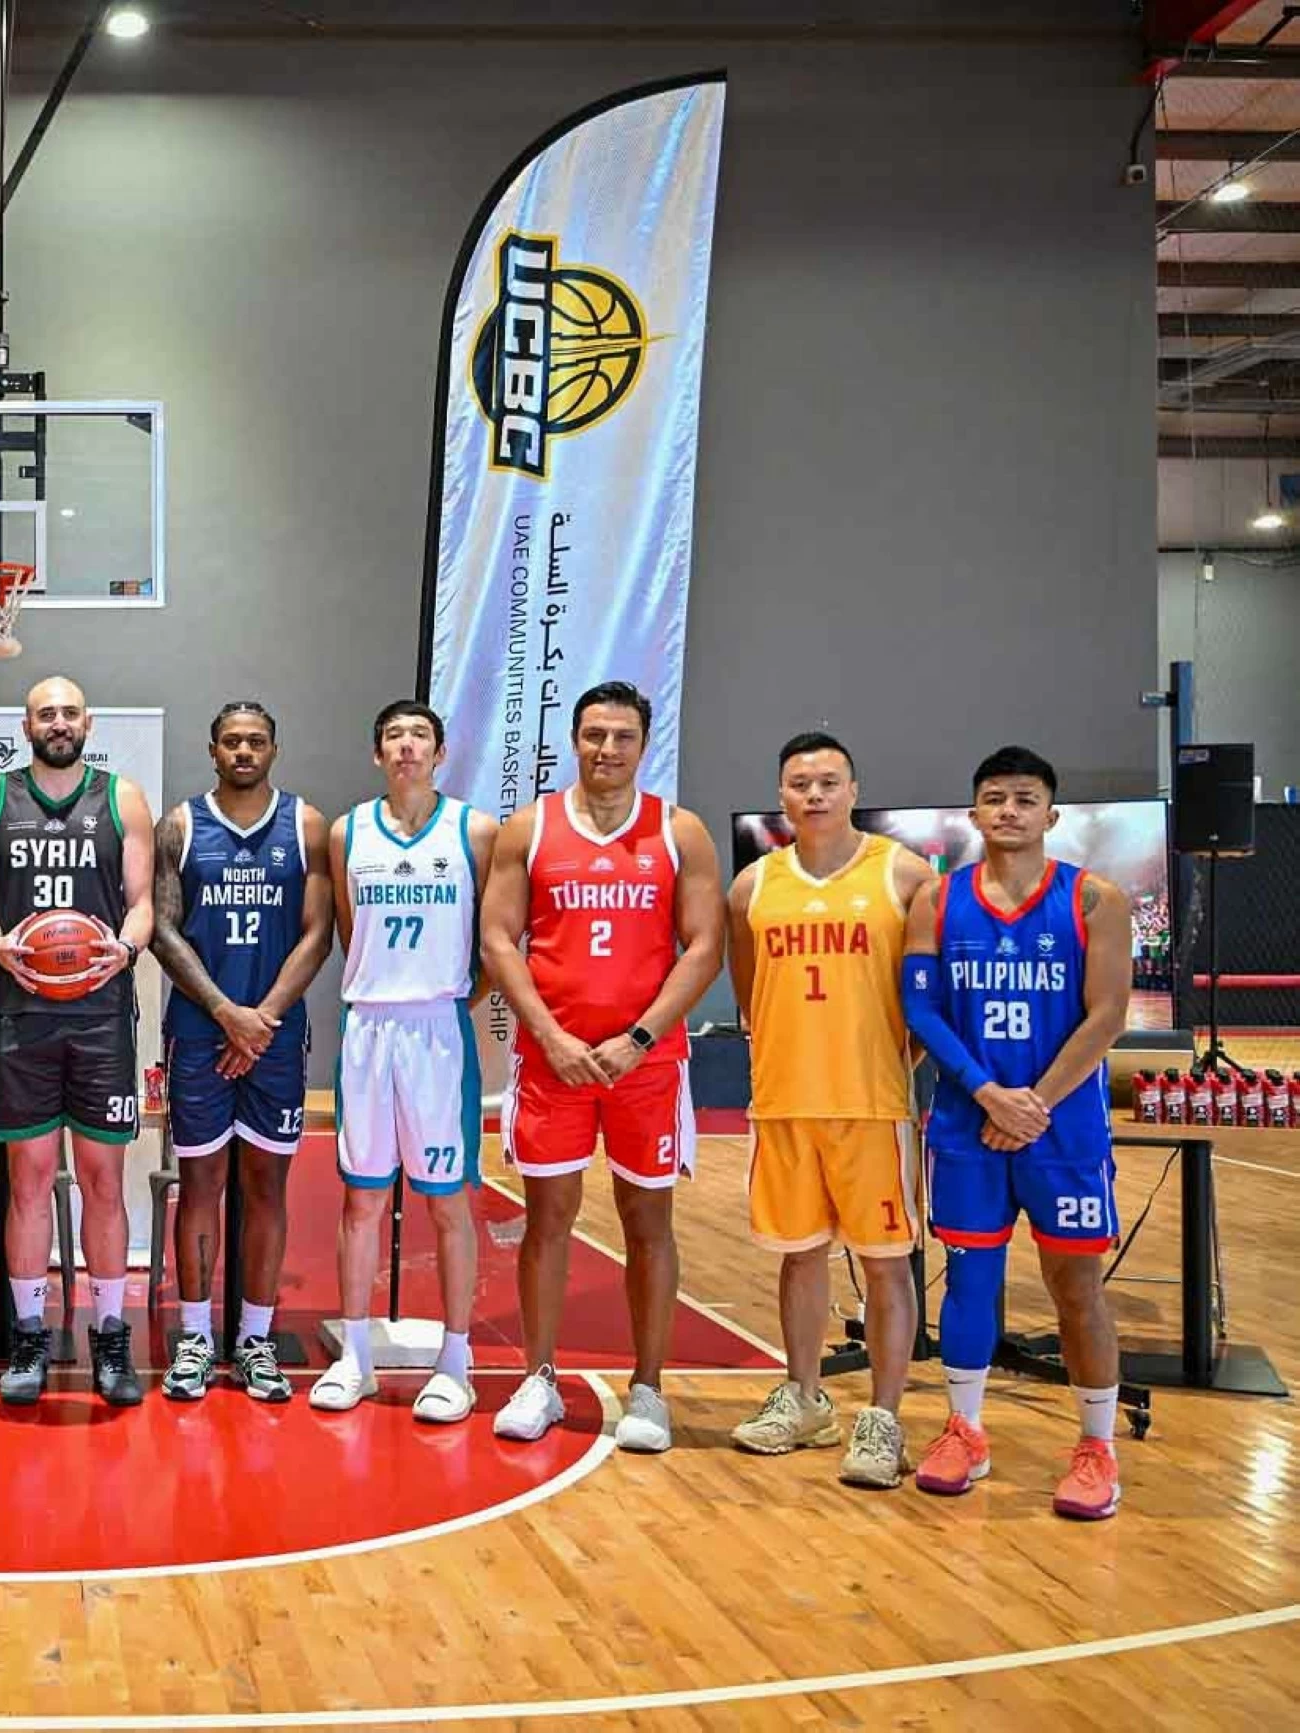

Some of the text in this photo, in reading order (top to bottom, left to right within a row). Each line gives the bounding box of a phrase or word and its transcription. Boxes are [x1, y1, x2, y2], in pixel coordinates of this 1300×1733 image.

[499, 246, 549, 467] UCBC
[512, 514, 531, 561] UAE
[504, 565, 531, 724] COMMUNITIES
[10, 838, 97, 868] SYRIA
[33, 875, 74, 908] 30
[222, 867, 267, 883] NORTH
[201, 884, 283, 906] AMERICA
[356, 883, 457, 906] UZBEKISTAN
[549, 880, 659, 911] TÜRKİYE
[225, 911, 261, 945] 12
[384, 916, 424, 950] 77
[589, 919, 613, 956] 2
[764, 922, 870, 959] CHINA
[804, 965, 828, 1001] 1
[950, 960, 1067, 991] PILIPINAS
[983, 1000, 1031, 1040] 28
[106, 1095, 136, 1122] 30
[424, 1145, 457, 1175] 77
[657, 1135, 673, 1164] 2
[881, 1200, 900, 1231] 1
[1056, 1196, 1102, 1229] 28
